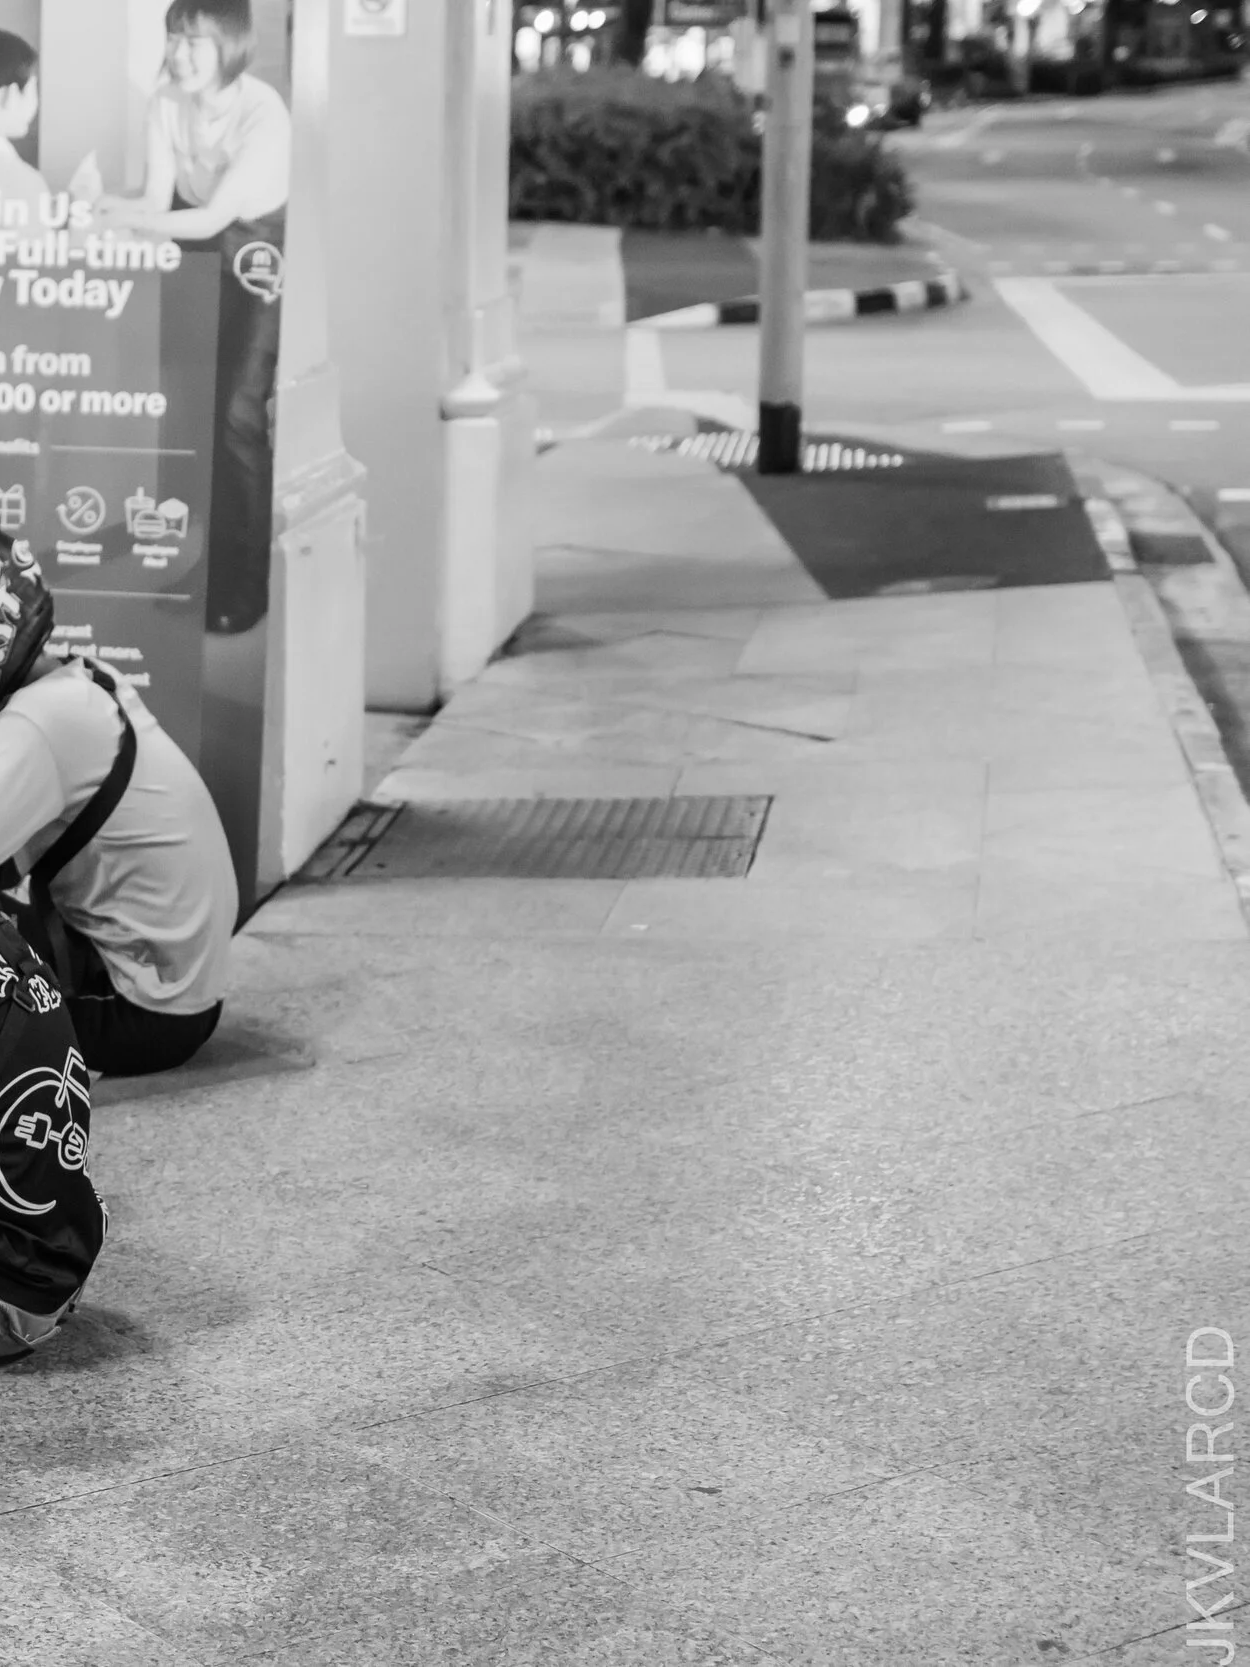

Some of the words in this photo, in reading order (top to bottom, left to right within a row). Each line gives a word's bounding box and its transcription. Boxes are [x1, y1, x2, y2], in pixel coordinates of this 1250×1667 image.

[38, 191, 94, 229] Us
[8, 268, 134, 319] Today
[11, 344, 91, 377] from
[39, 388, 77, 414] or
[80, 389, 167, 418] more
